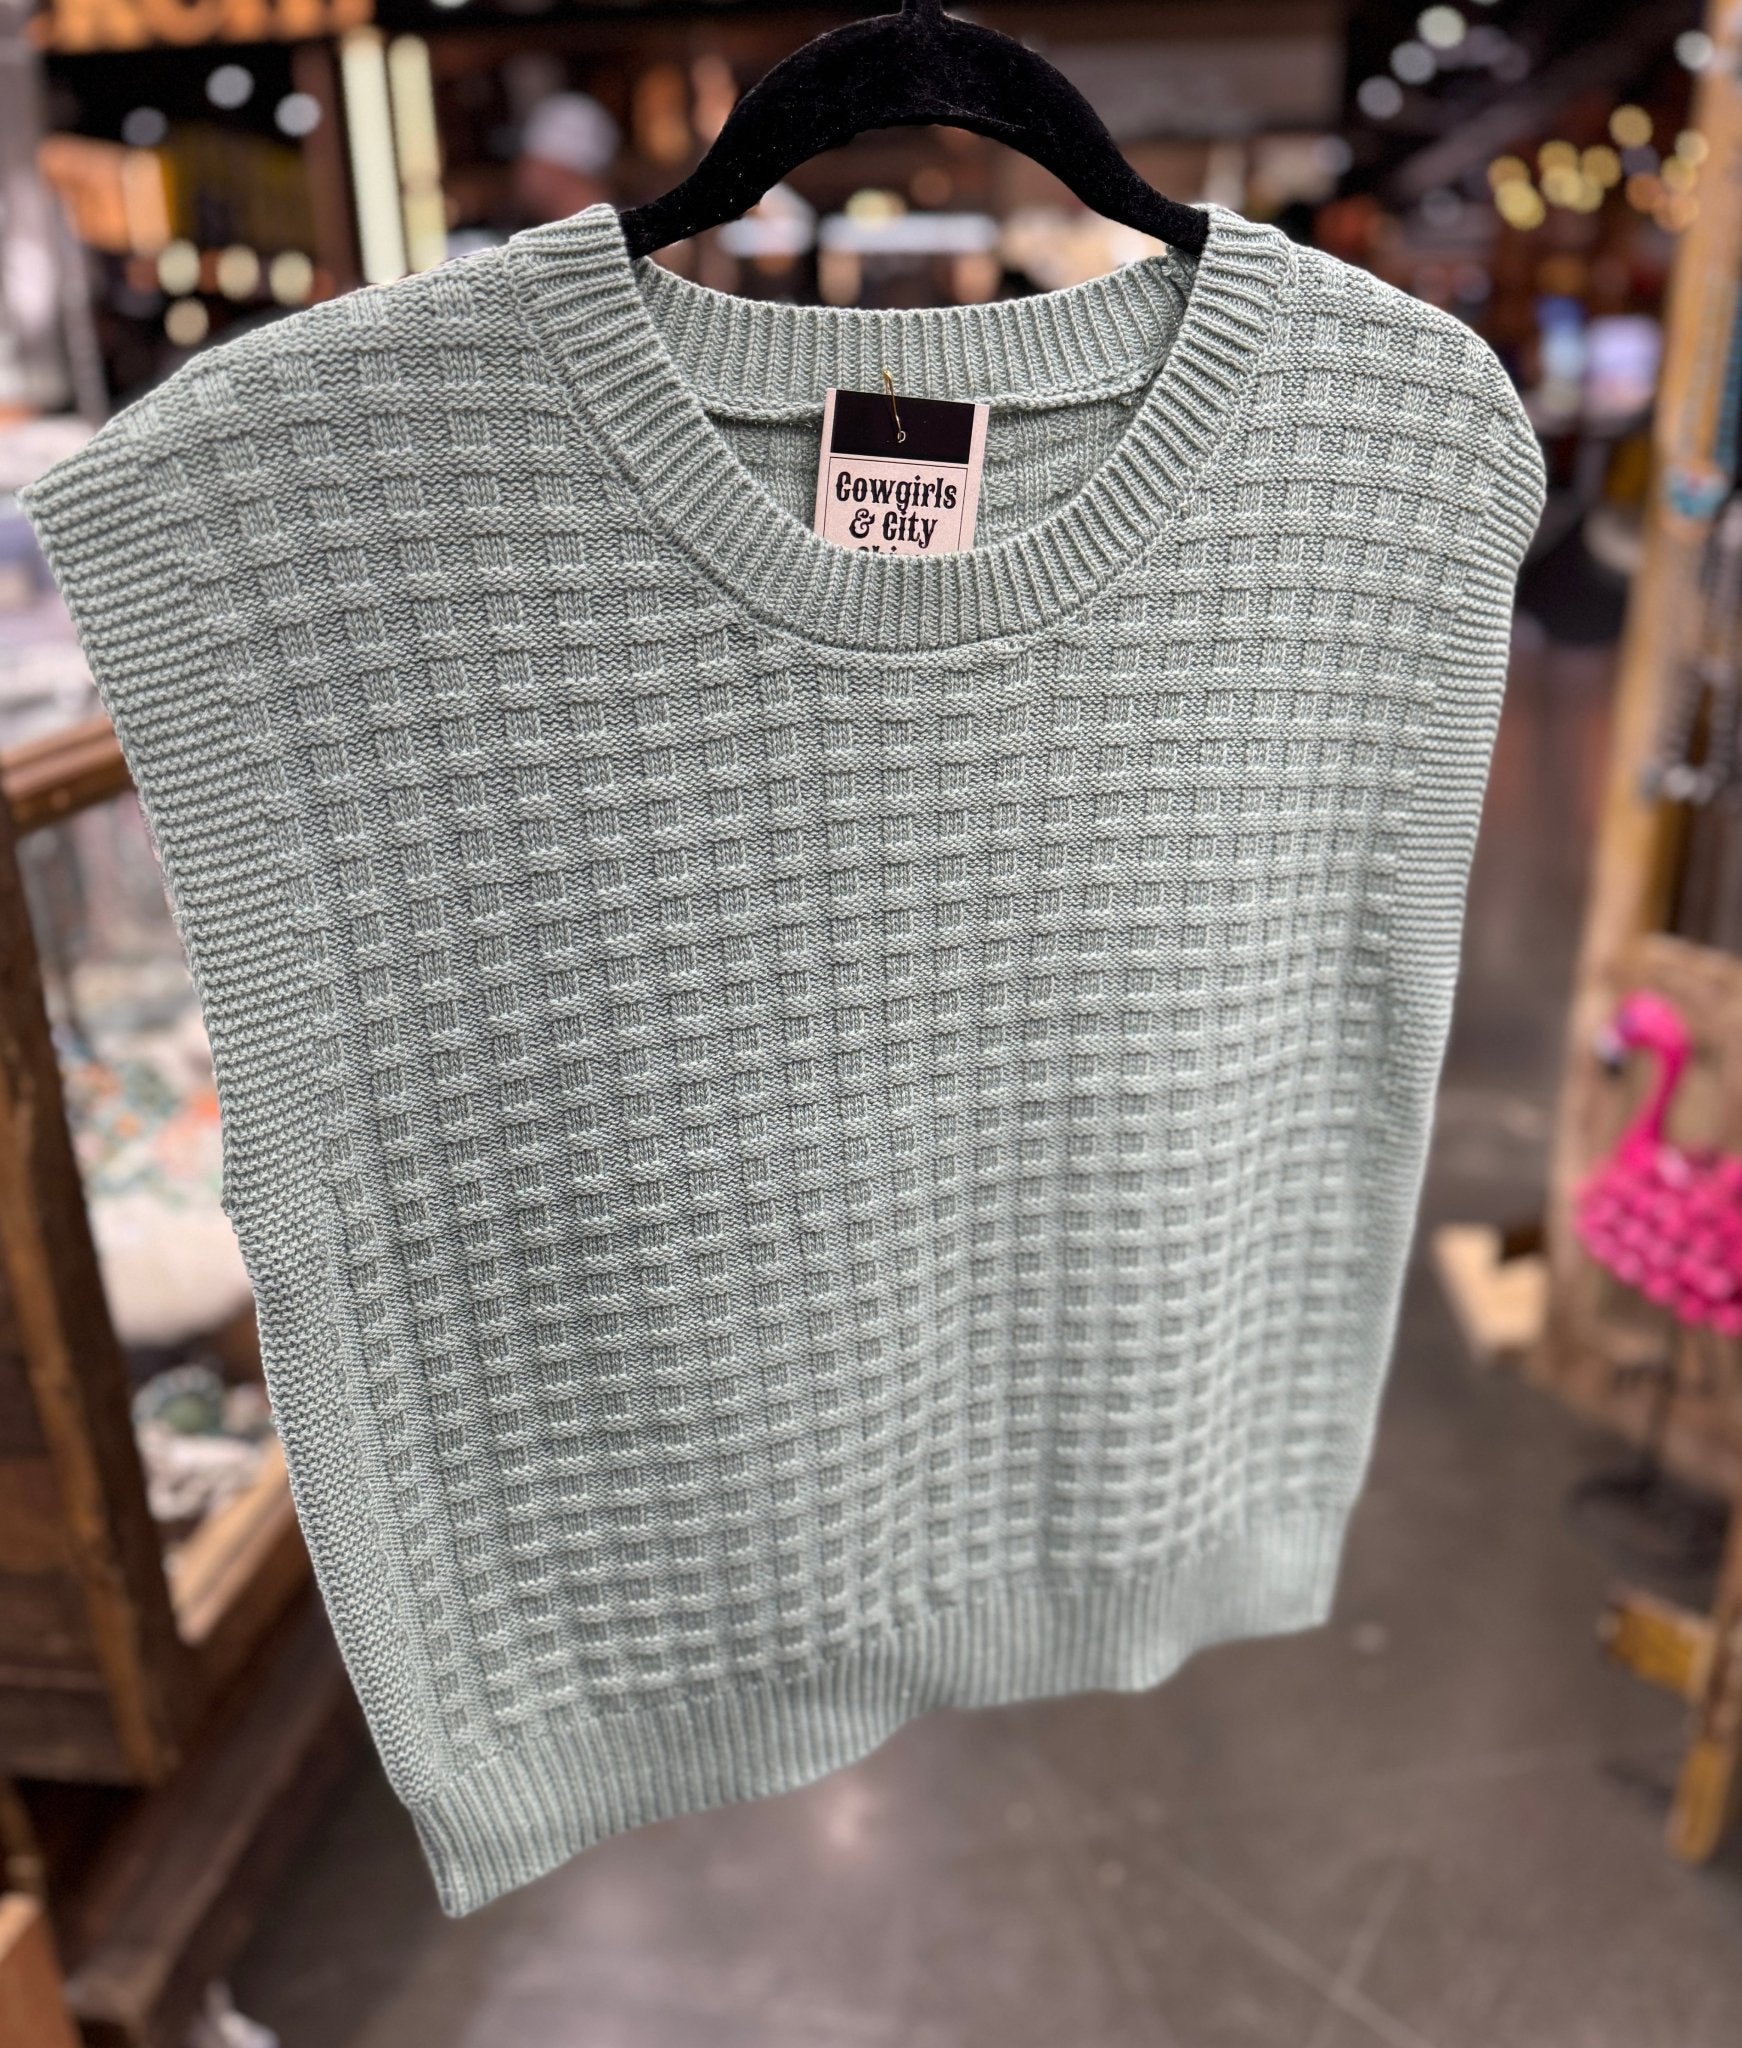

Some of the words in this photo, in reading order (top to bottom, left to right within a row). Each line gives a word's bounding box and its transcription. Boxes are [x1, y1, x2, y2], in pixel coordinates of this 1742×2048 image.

[836, 471, 957, 512] Cowgirls
[849, 508, 875, 539] &
[883, 510, 938, 549] City
